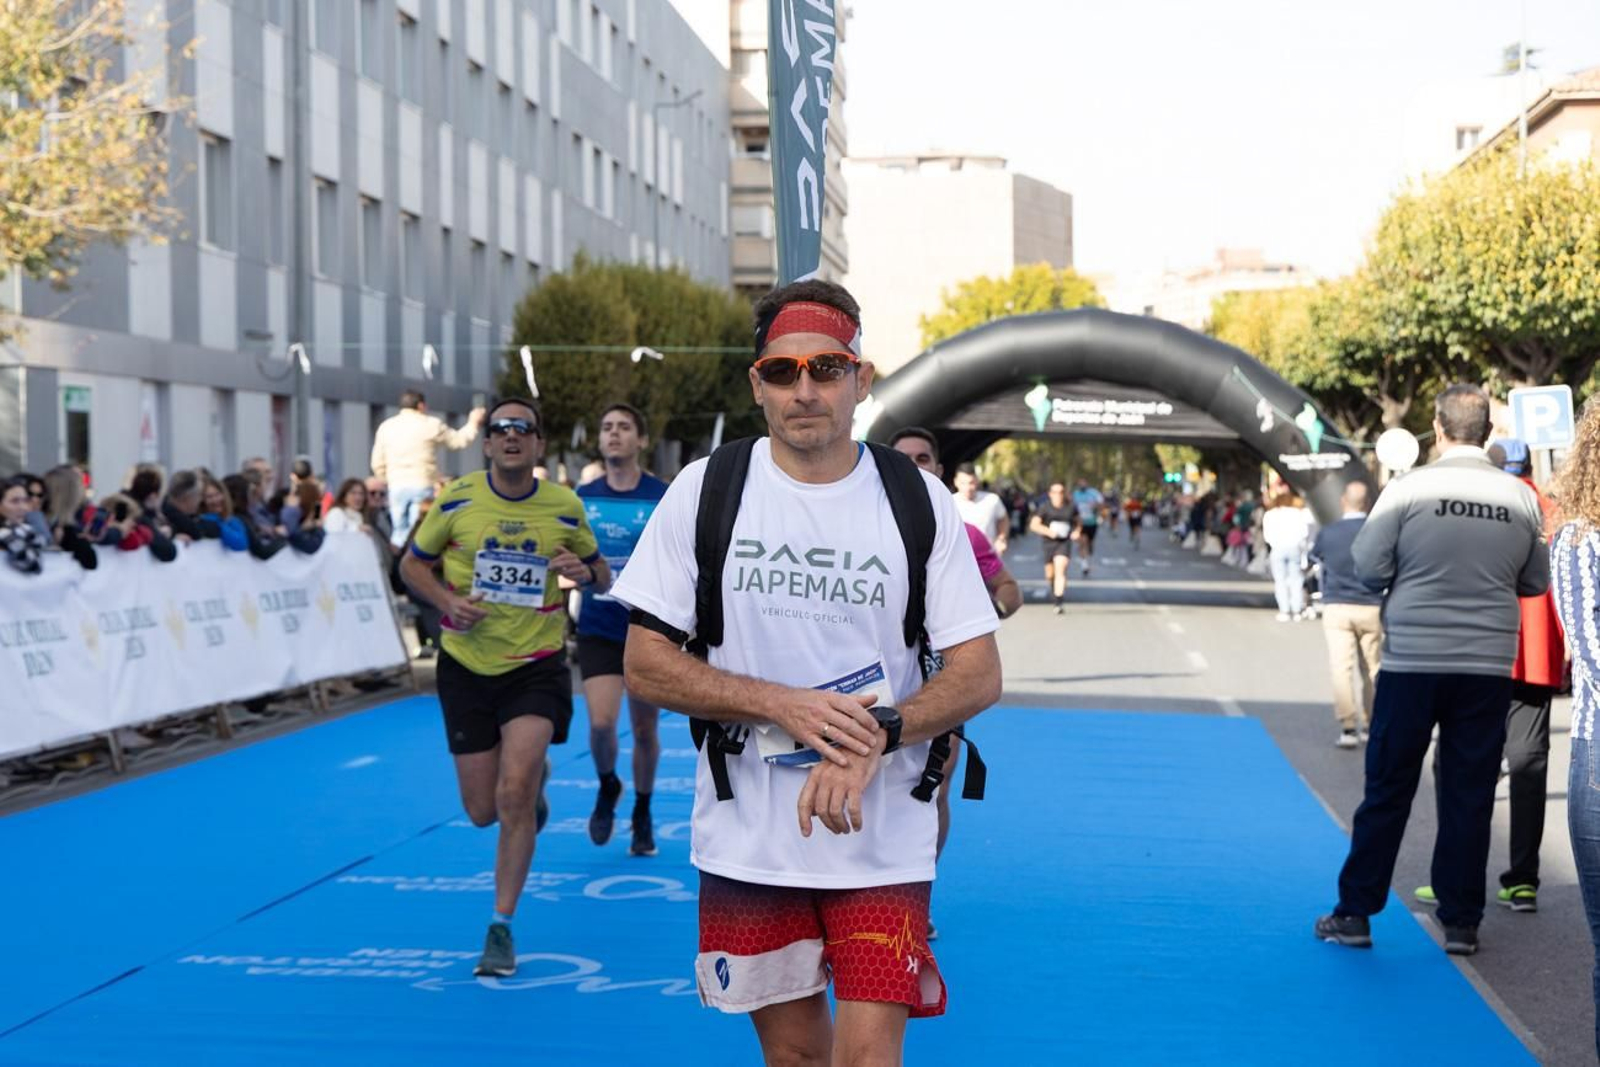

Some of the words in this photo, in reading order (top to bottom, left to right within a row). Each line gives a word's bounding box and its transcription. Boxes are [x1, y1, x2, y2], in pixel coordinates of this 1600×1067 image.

[1521, 394, 1560, 443] P
[489, 565, 533, 586] 334
[734, 539, 892, 576] DACIA
[733, 566, 886, 608] JAPEMASA
[813, 613, 856, 625] OFICIAL
